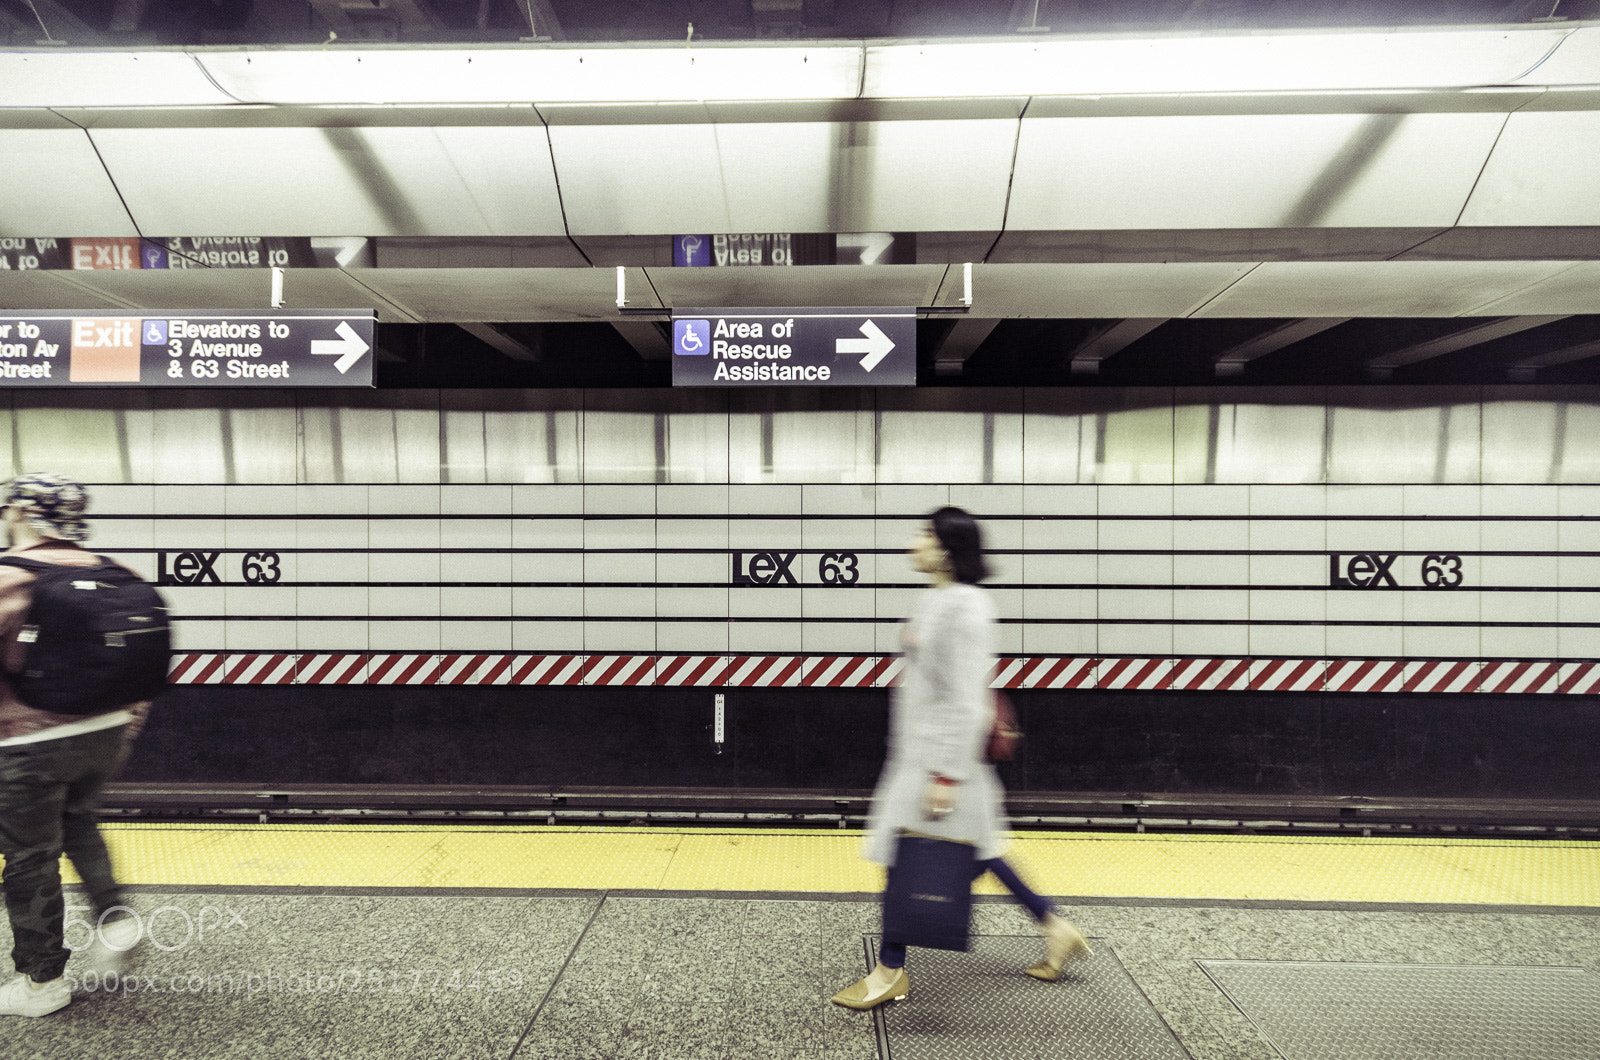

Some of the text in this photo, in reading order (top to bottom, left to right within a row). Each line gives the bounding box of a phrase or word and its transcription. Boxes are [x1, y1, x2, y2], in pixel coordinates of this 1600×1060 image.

[17, 320, 40, 339] to
[73, 321, 133, 348] Exit
[168, 320, 290, 339] Elevators to
[713, 318, 794, 339] Area of
[33, 339, 60, 358] Av
[168, 340, 262, 358] 3 Avenue
[713, 340, 792, 360] Rescue
[167, 360, 290, 379] & 63 Street
[714, 362, 831, 381] Assistance
[242, 552, 281, 583] 63
[819, 553, 859, 584] 63
[1421, 554, 1463, 587] 63
